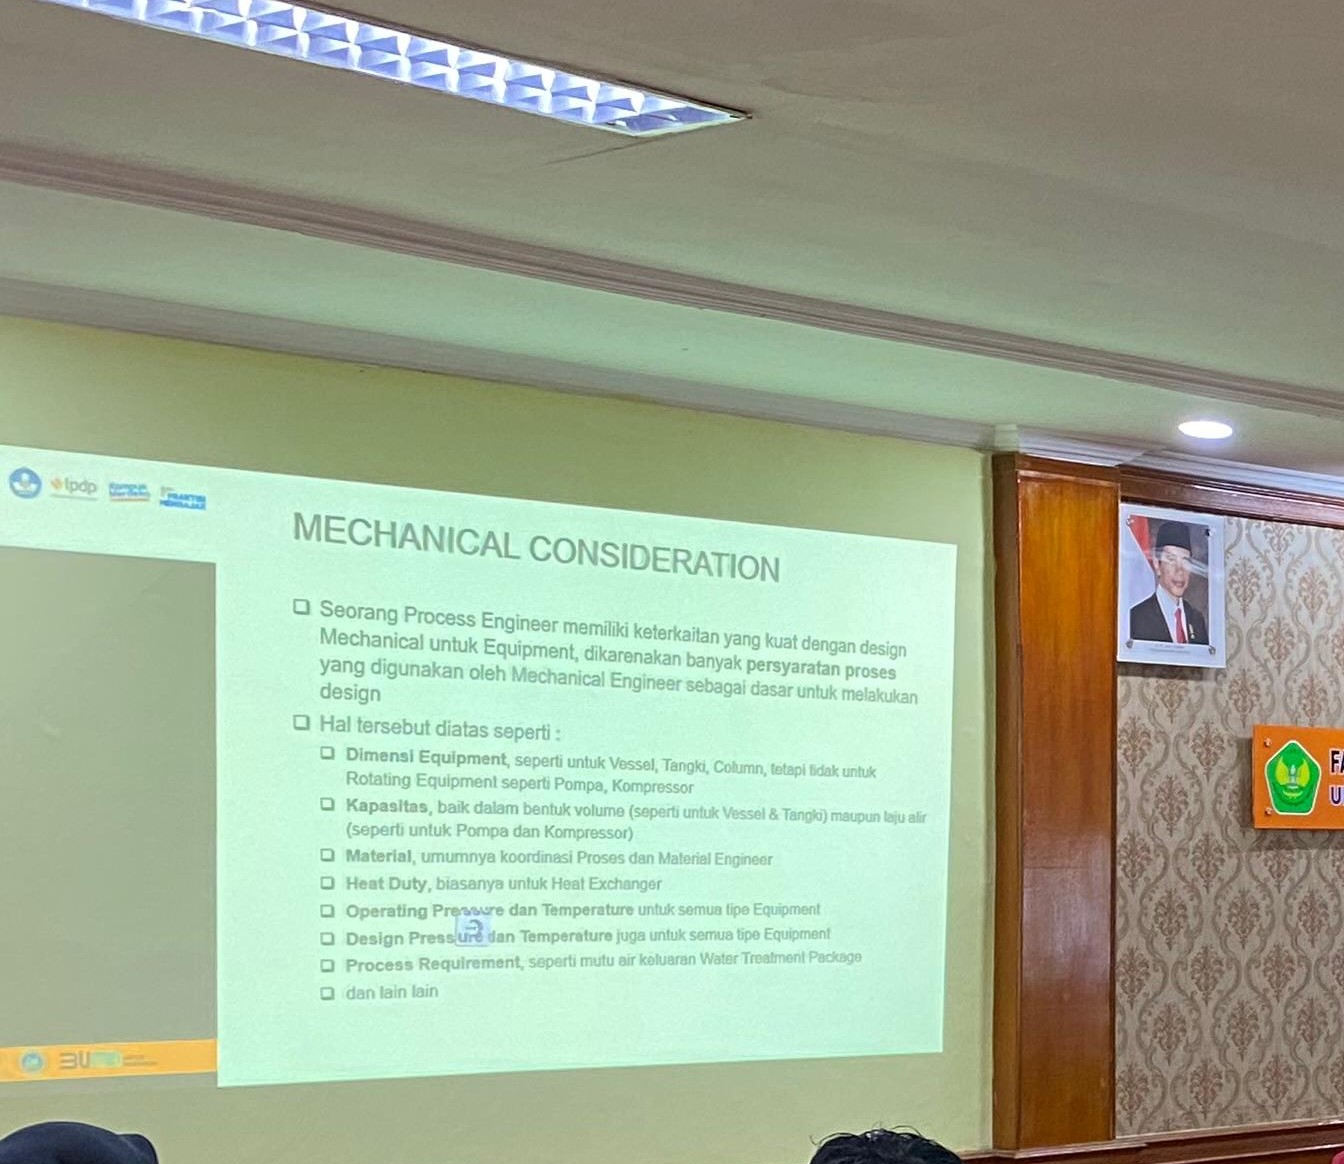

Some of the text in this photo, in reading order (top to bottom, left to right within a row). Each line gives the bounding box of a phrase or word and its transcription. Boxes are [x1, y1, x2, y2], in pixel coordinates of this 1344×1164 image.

[65, 478, 97, 494] lpdp
[293, 511, 780, 583] MECHANICAL CONSIDERATION
[320, 600, 907, 660] Seorang Process Engineer memiliki keterkaitan yang kuat dengan design
[320, 627, 896, 681] Mechanical untuk Equipment, dikarenakan banyak persyaratan proses
[320, 658, 918, 705] yang digunakan oleh Mechanical Engineer sebagai dasar untuk melakukan
[320, 683, 381, 705] design
[320, 715, 551, 743] Hal tersebut diatas seperti
[346, 747, 877, 779] Dimensi Equipment, seperti untuk Vessel, Tangki, Column, tetapi tidak untuk
[346, 771, 694, 797] Rotating Equipment seperti Pompa, Kompressor
[346, 798, 432, 816] Kapasitas,
[438, 800, 469, 815] baik
[474, 801, 519, 816] dalam
[523, 802, 570, 817] bentuk
[575, 803, 625, 819] volume
[629, 804, 679, 821] (seperti
[683, 805, 719, 820] untuk
[723, 806, 766, 821] Vessel
[769, 807, 779, 821] &
[783, 807, 828, 824] Tangki)
[831, 811, 881, 826] maupun
[346, 822, 634, 842] (seperti untuk Pompa dan Kompressor)
[346, 849, 774, 868] Material, umumnya koordinasi Proses dan Material Engineer
[346, 876, 662, 894] Heat Duty, biasanya untuk Heat Exchanger
[346, 903, 821, 920] Operating Pressure dan Temperature untuk semua tipe Equipment
[346, 932, 404, 948] Design
[488, 931, 515, 944] dan
[521, 930, 612, 945] Temperature
[616, 928, 646, 945] juga
[650, 928, 686, 942] untuk
[689, 929, 734, 942] semua
[737, 928, 761, 944] tipe
[764, 927, 831, 943] Equipment
[346, 949, 862, 973] Process Requirement, seperti mutu air keluaran Water Treatment Package
[346, 984, 439, 1001] dan lain lain
